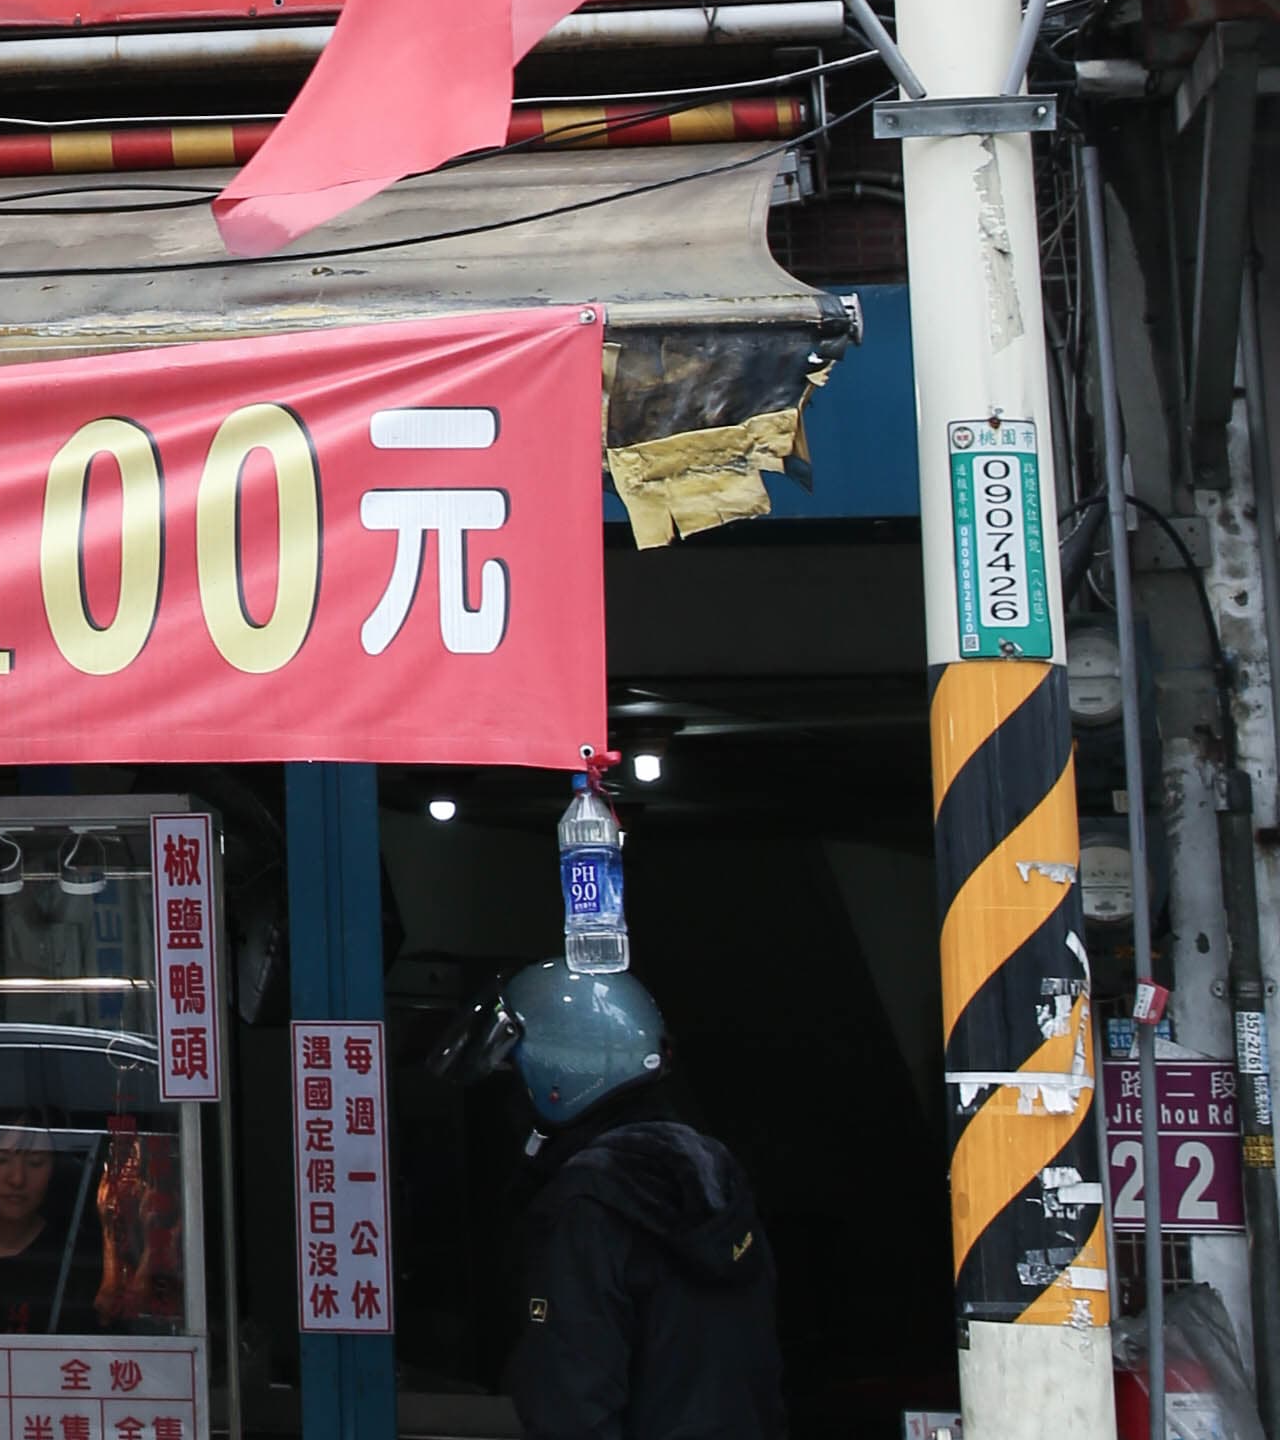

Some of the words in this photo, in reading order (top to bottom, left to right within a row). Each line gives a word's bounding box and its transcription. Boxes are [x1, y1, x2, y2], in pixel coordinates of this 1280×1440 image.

[983, 459, 1019, 621] 0907426
[571, 882, 598, 903] 9.0
[572, 865, 596, 883] PH
[163, 833, 209, 1082] 椒鹽鴨頭
[1113, 1102, 1199, 1125] Jiehou
[1208, 1104, 1234, 1125] Rd
[302, 1034, 340, 1320] 遇國定假日沒休
[343, 1034, 382, 1321] 每週一公休
[60, 1359, 143, 1393] 全炒
